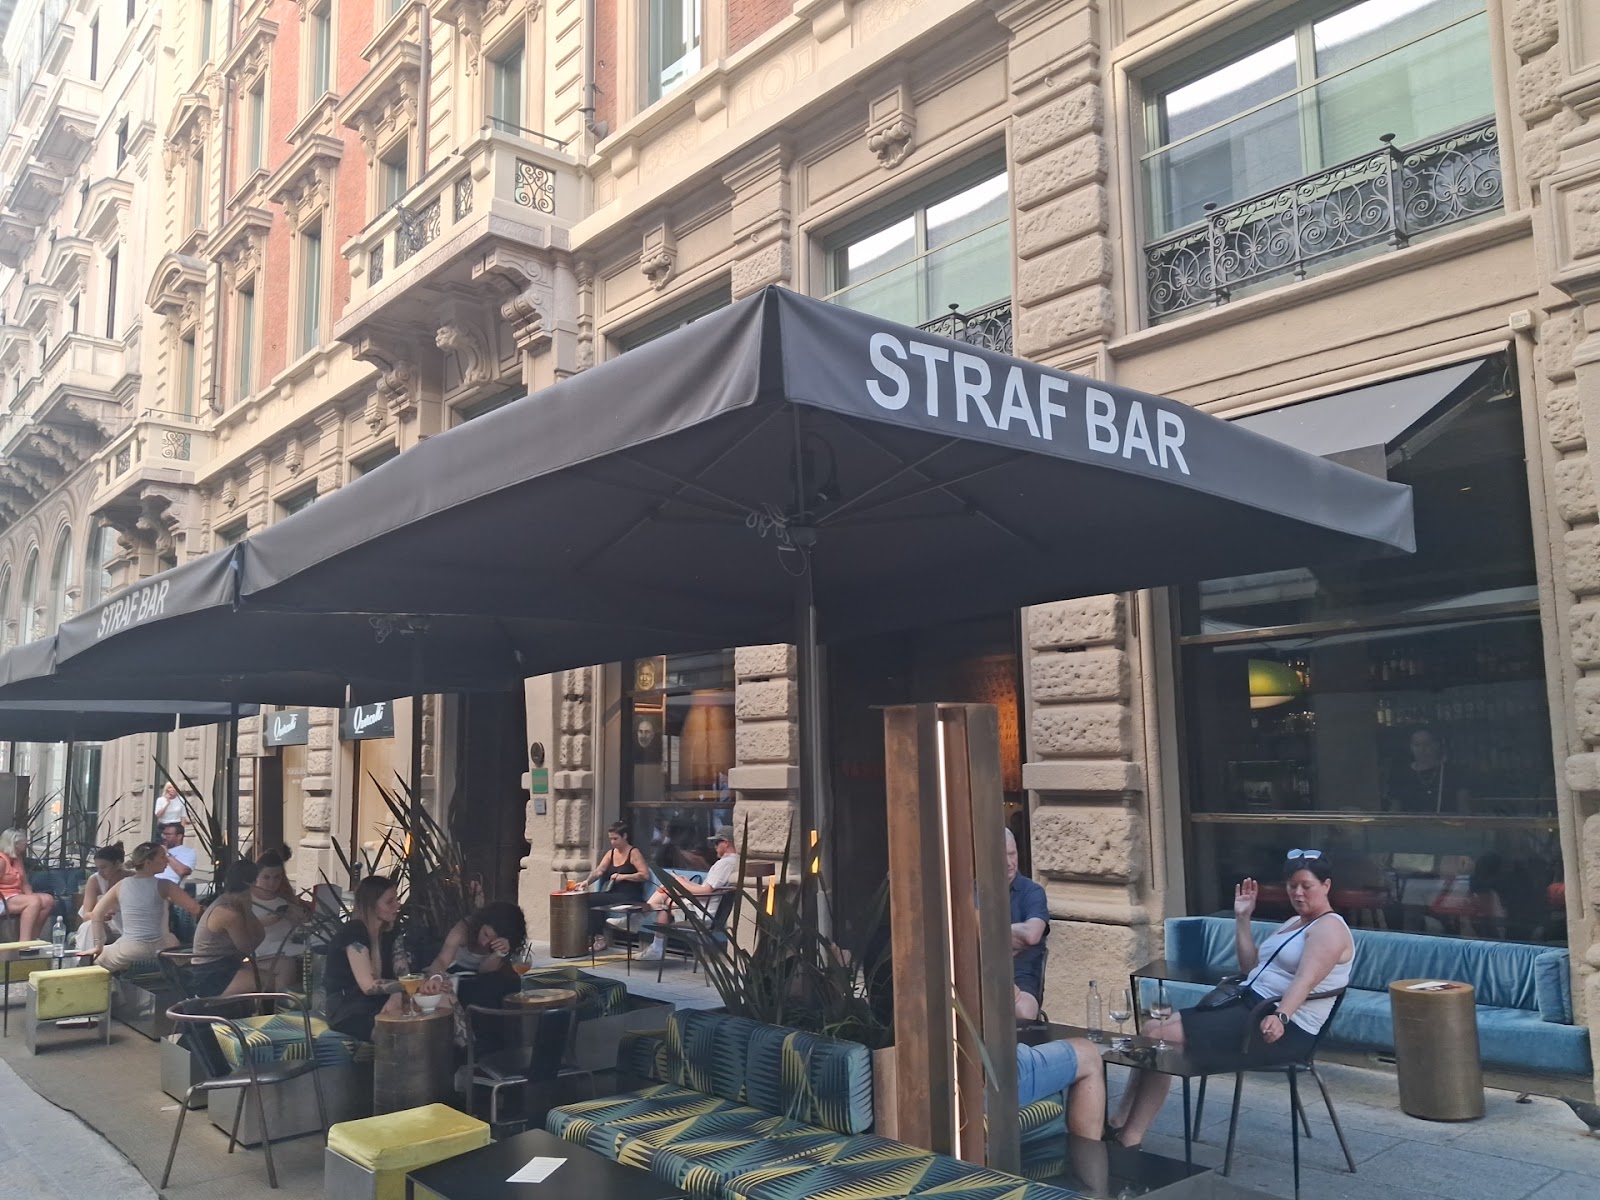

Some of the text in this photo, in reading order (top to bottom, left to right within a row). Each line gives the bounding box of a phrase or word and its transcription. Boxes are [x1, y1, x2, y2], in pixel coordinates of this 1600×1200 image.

[866, 332, 1190, 475] STRAF BAR
[97, 579, 170, 638] STRAF BAR
